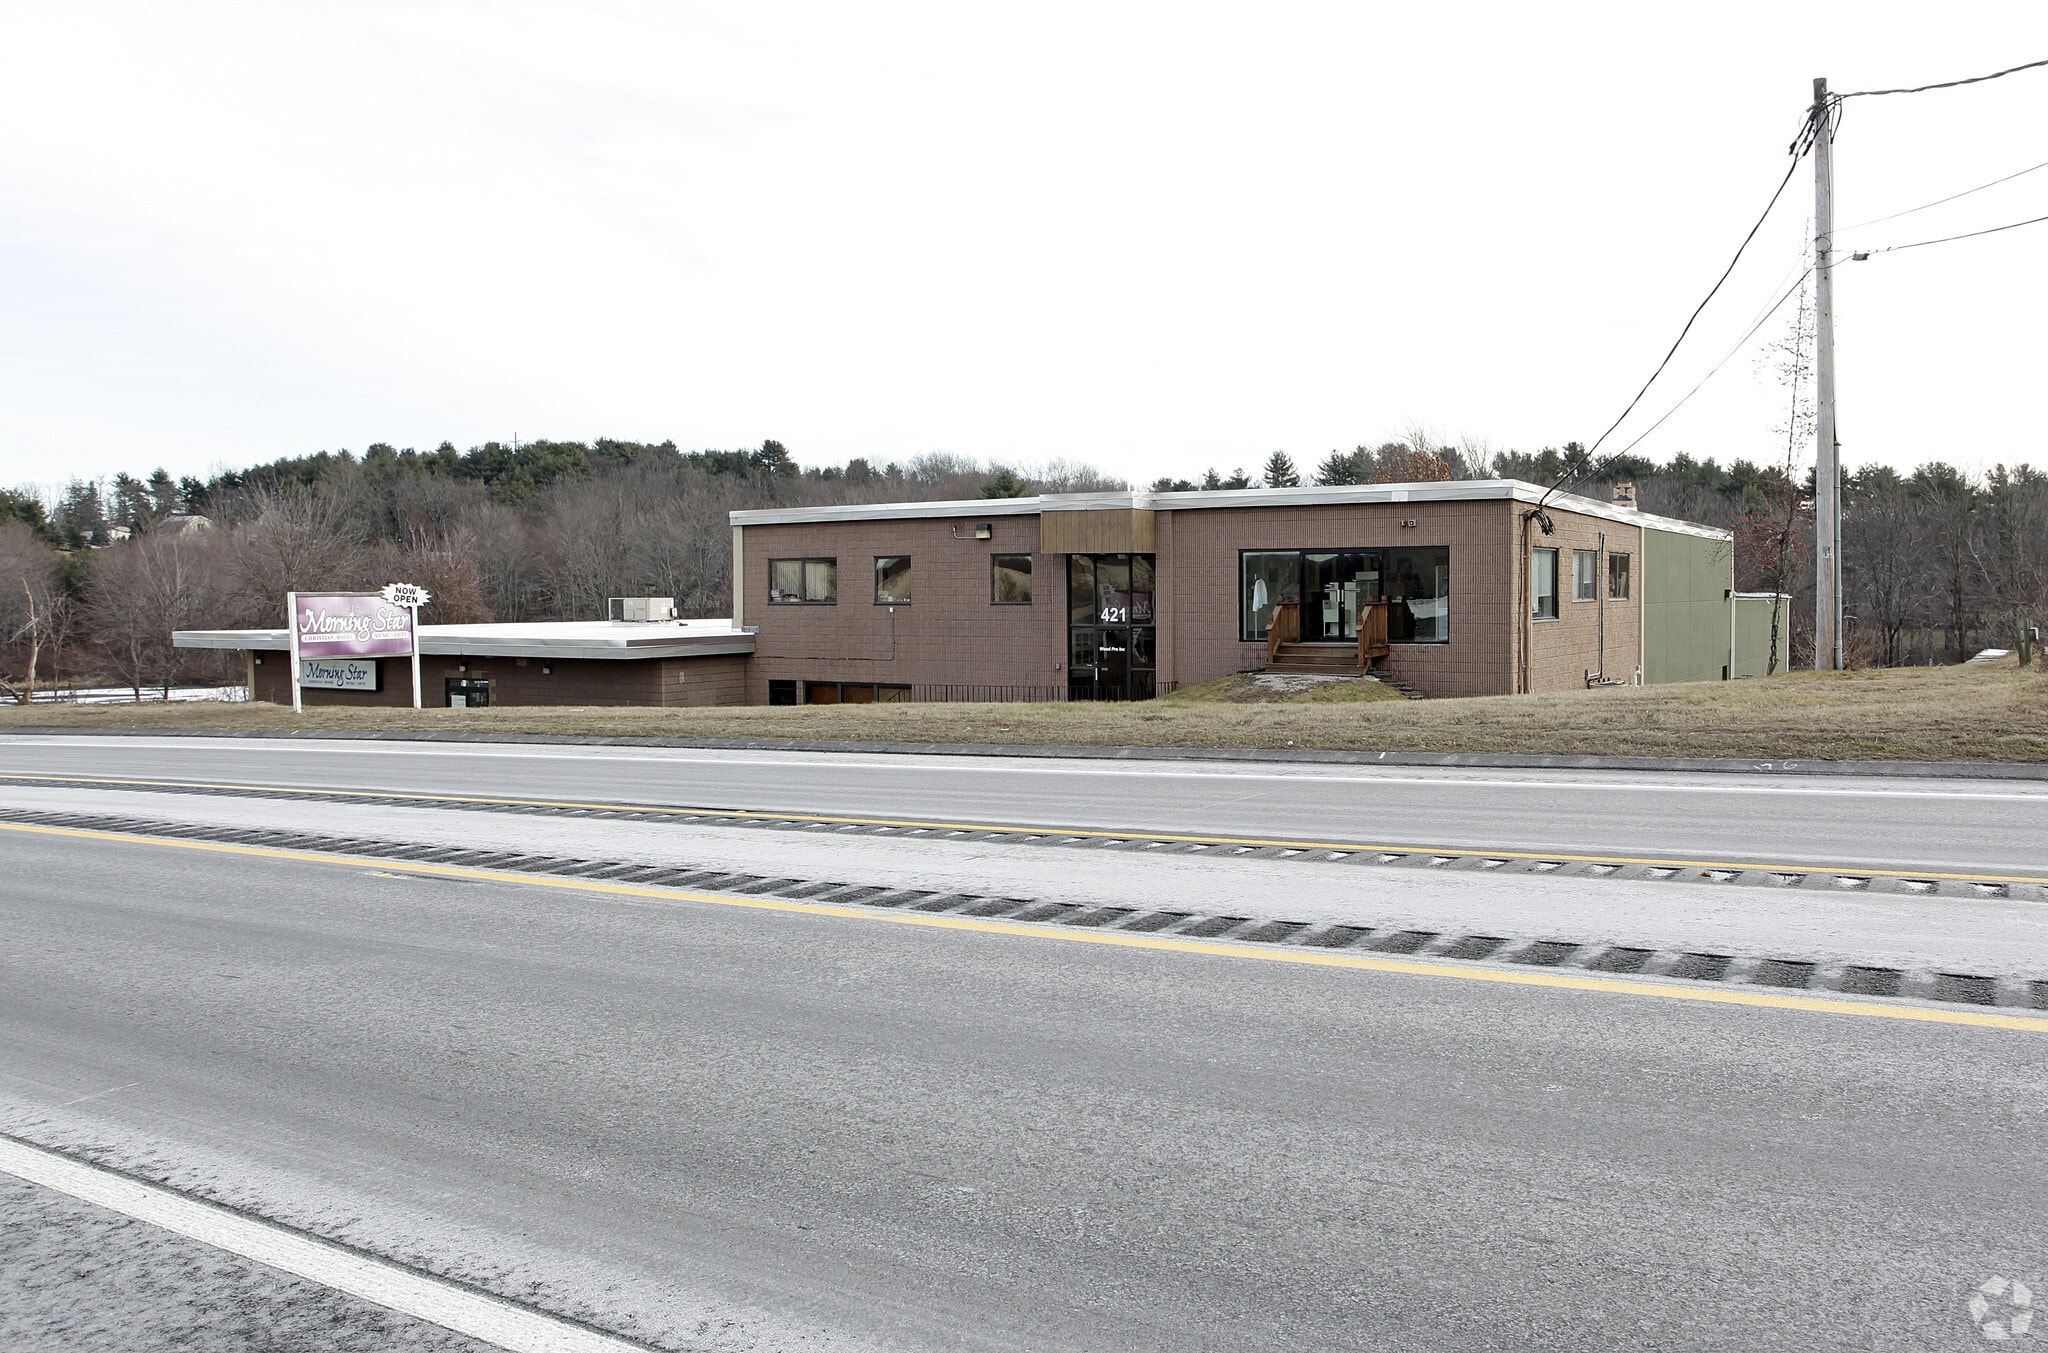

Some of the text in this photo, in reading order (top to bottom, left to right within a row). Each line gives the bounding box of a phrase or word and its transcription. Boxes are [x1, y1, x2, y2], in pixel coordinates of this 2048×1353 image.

[395, 587, 417, 595] NOW
[393, 595, 418, 604] OPEN
[1100, 607, 1126, 622] 421
[299, 606, 410, 642] Morning Star
[306, 662, 368, 687] Morning Star
